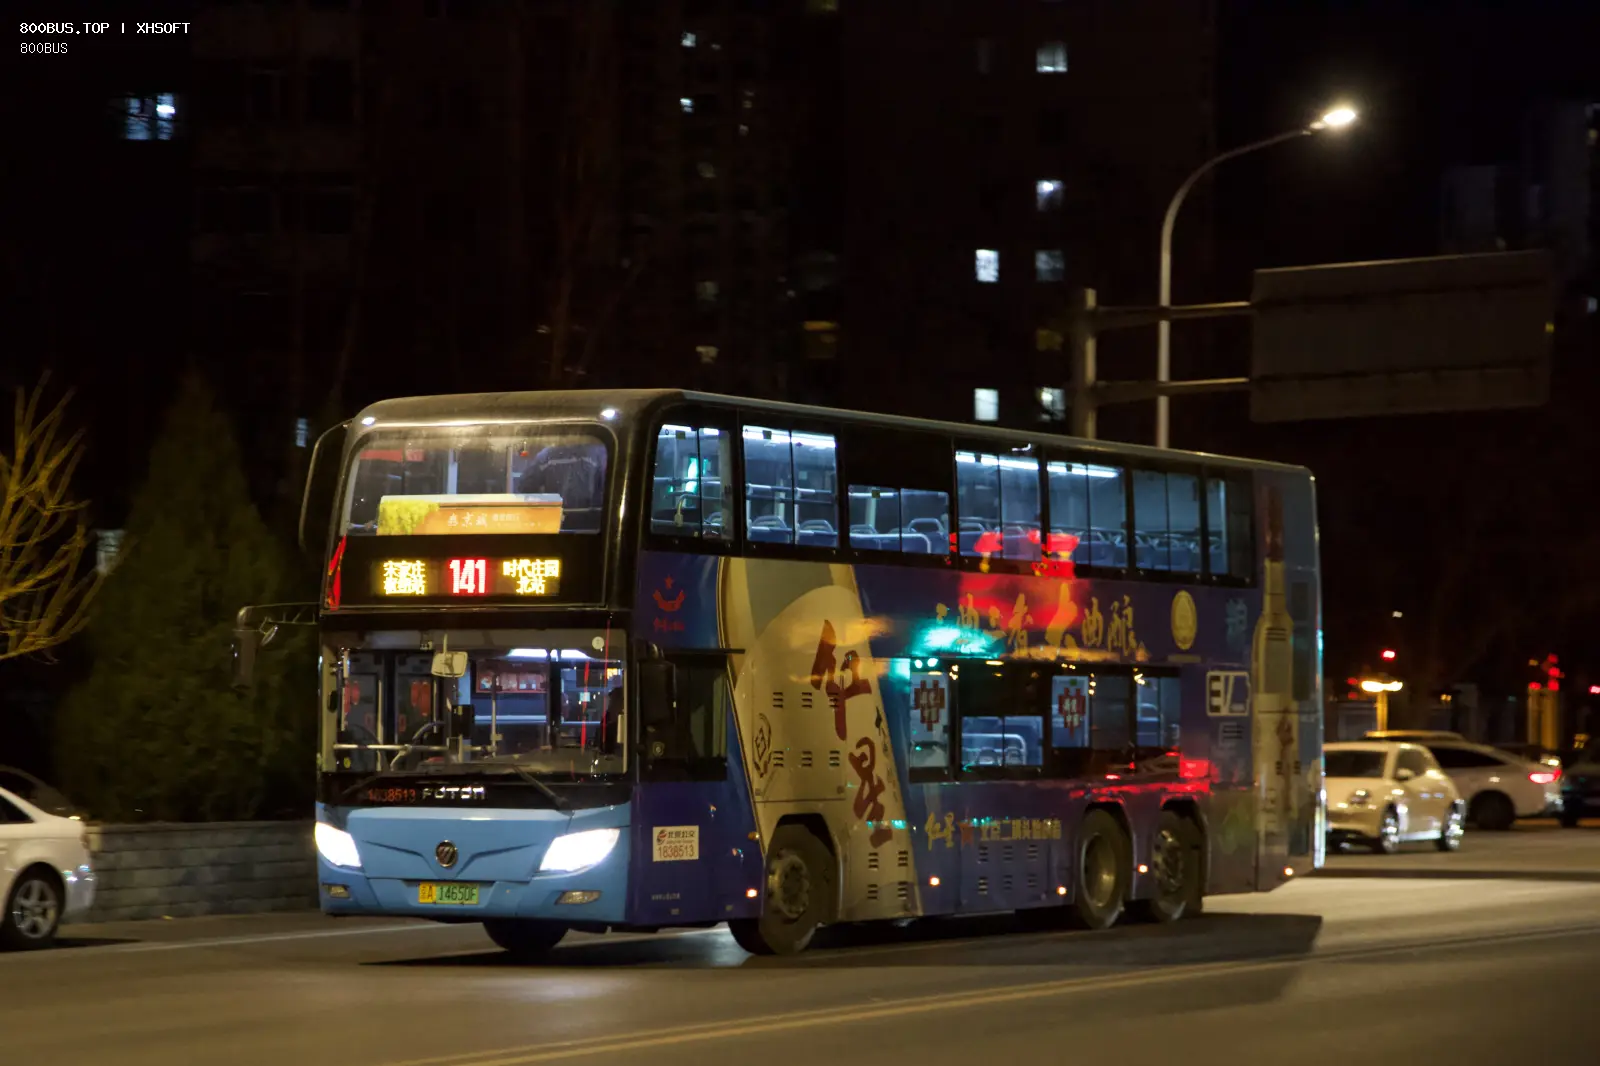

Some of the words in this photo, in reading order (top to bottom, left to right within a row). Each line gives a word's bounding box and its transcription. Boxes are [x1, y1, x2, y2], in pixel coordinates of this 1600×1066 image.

[449, 559, 486, 594] 141
[502, 559, 560, 577] 时代庄园
[658, 845, 695, 859] 1838513
